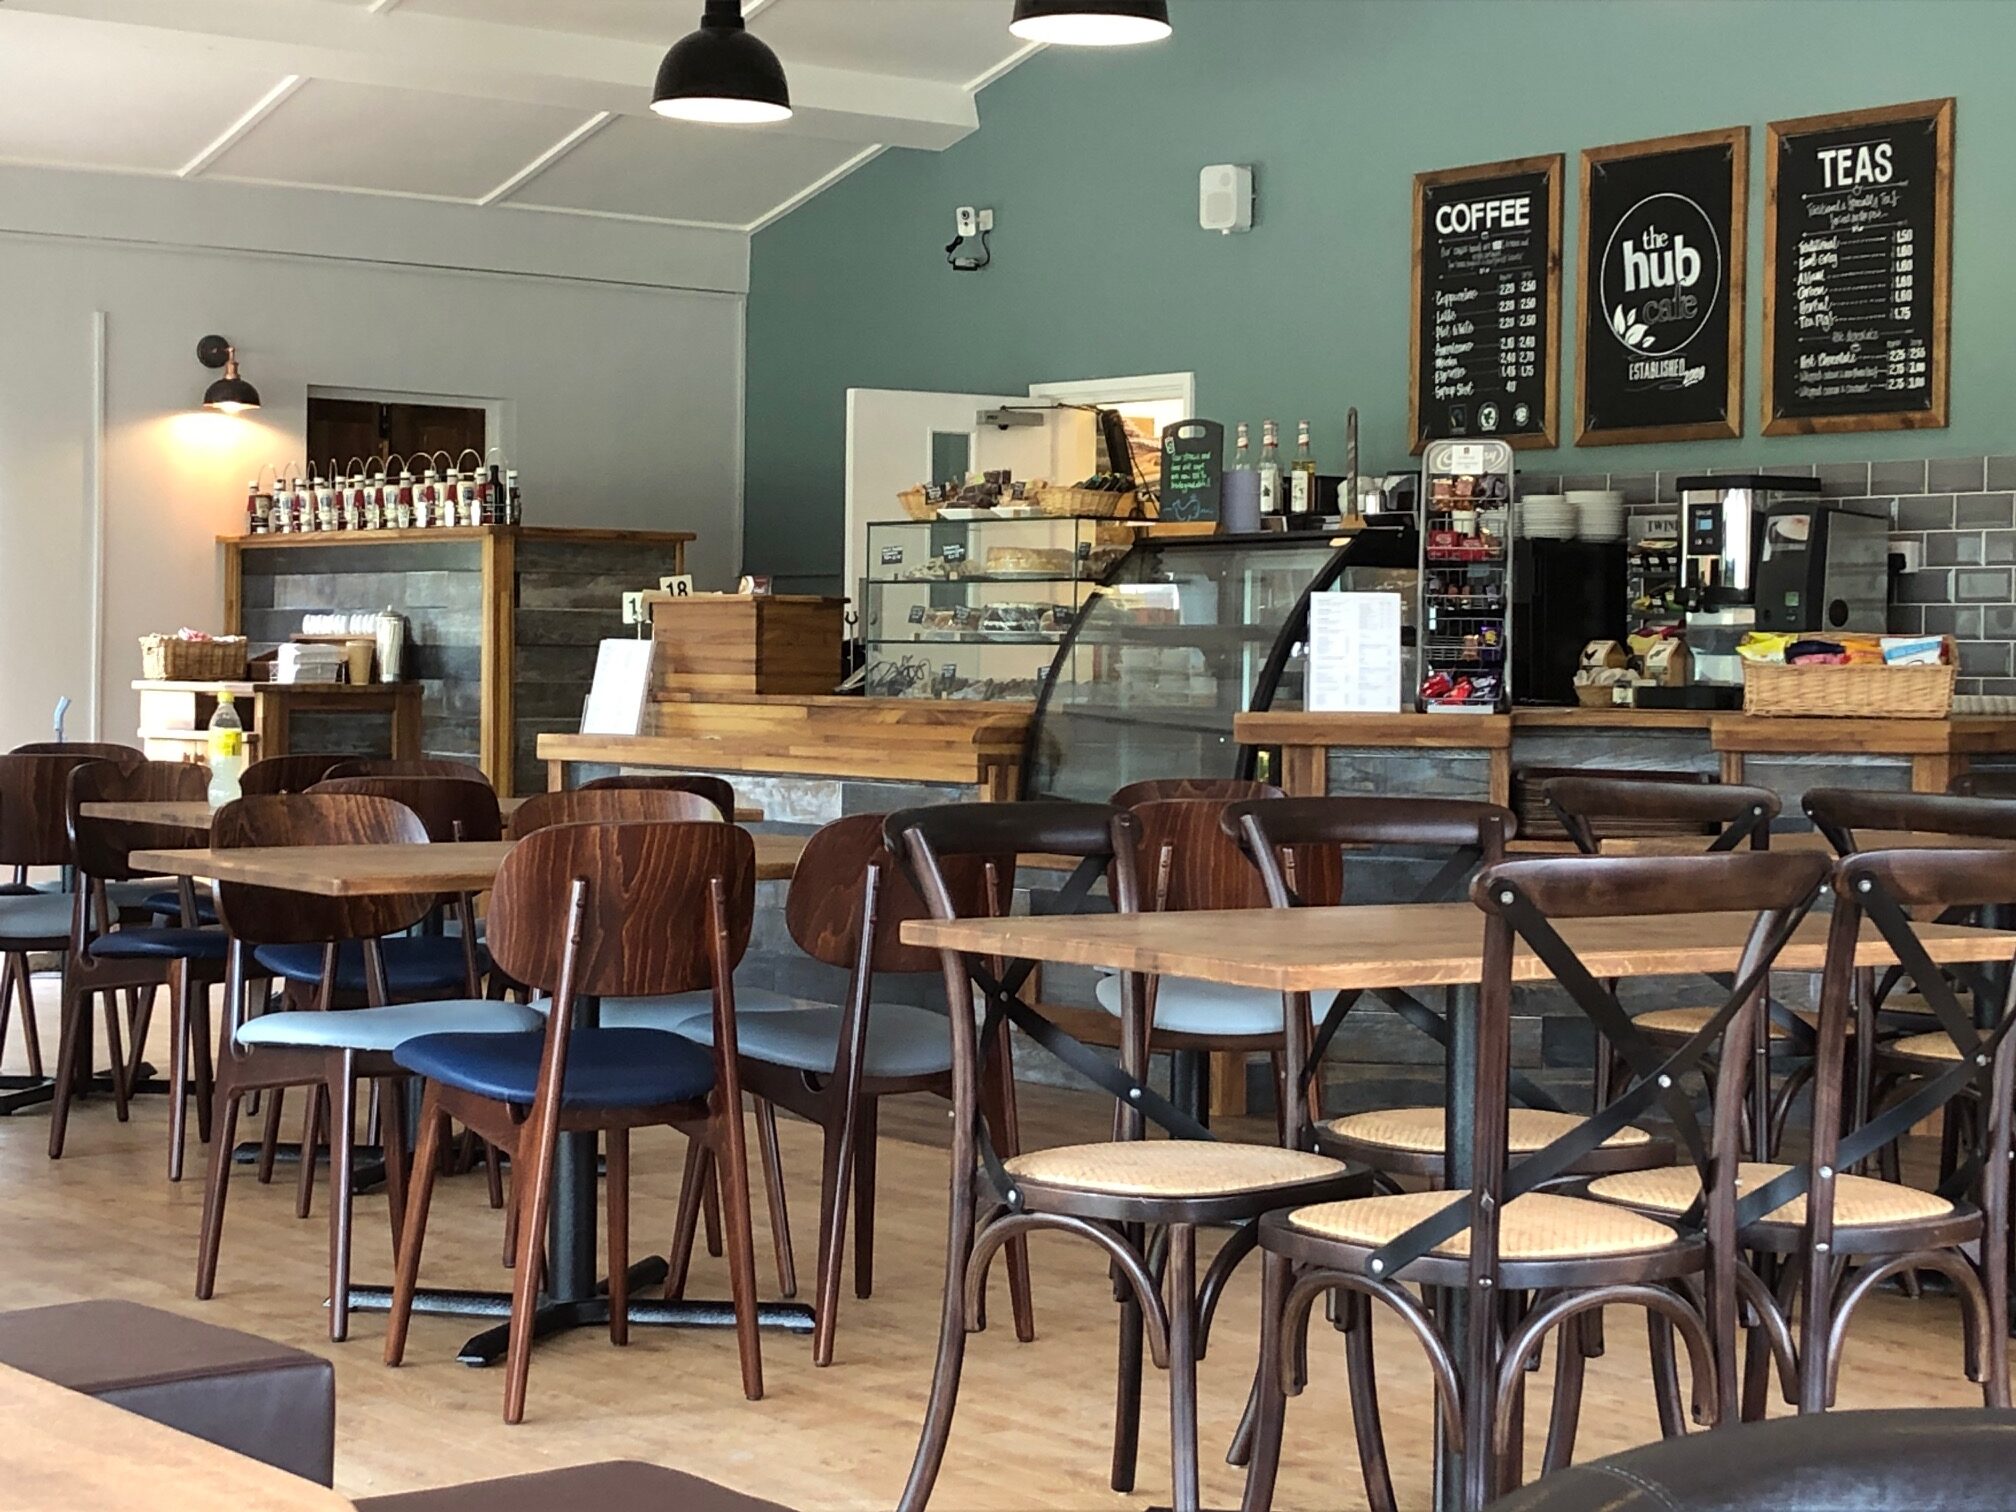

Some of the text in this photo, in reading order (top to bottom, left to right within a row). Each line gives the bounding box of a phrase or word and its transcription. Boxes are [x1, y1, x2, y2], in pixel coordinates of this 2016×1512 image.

[1817, 143, 1893, 188] TEAS
[1435, 197, 1530, 234] COFFEE
[1642, 224, 1669, 250] the
[1622, 235, 1701, 292] hub
[1797, 286, 1828, 300] Green
[1629, 358, 1686, 380] ESTABLISHED
[666, 581, 688, 597] 18
[629, 597, 639, 616] 1
